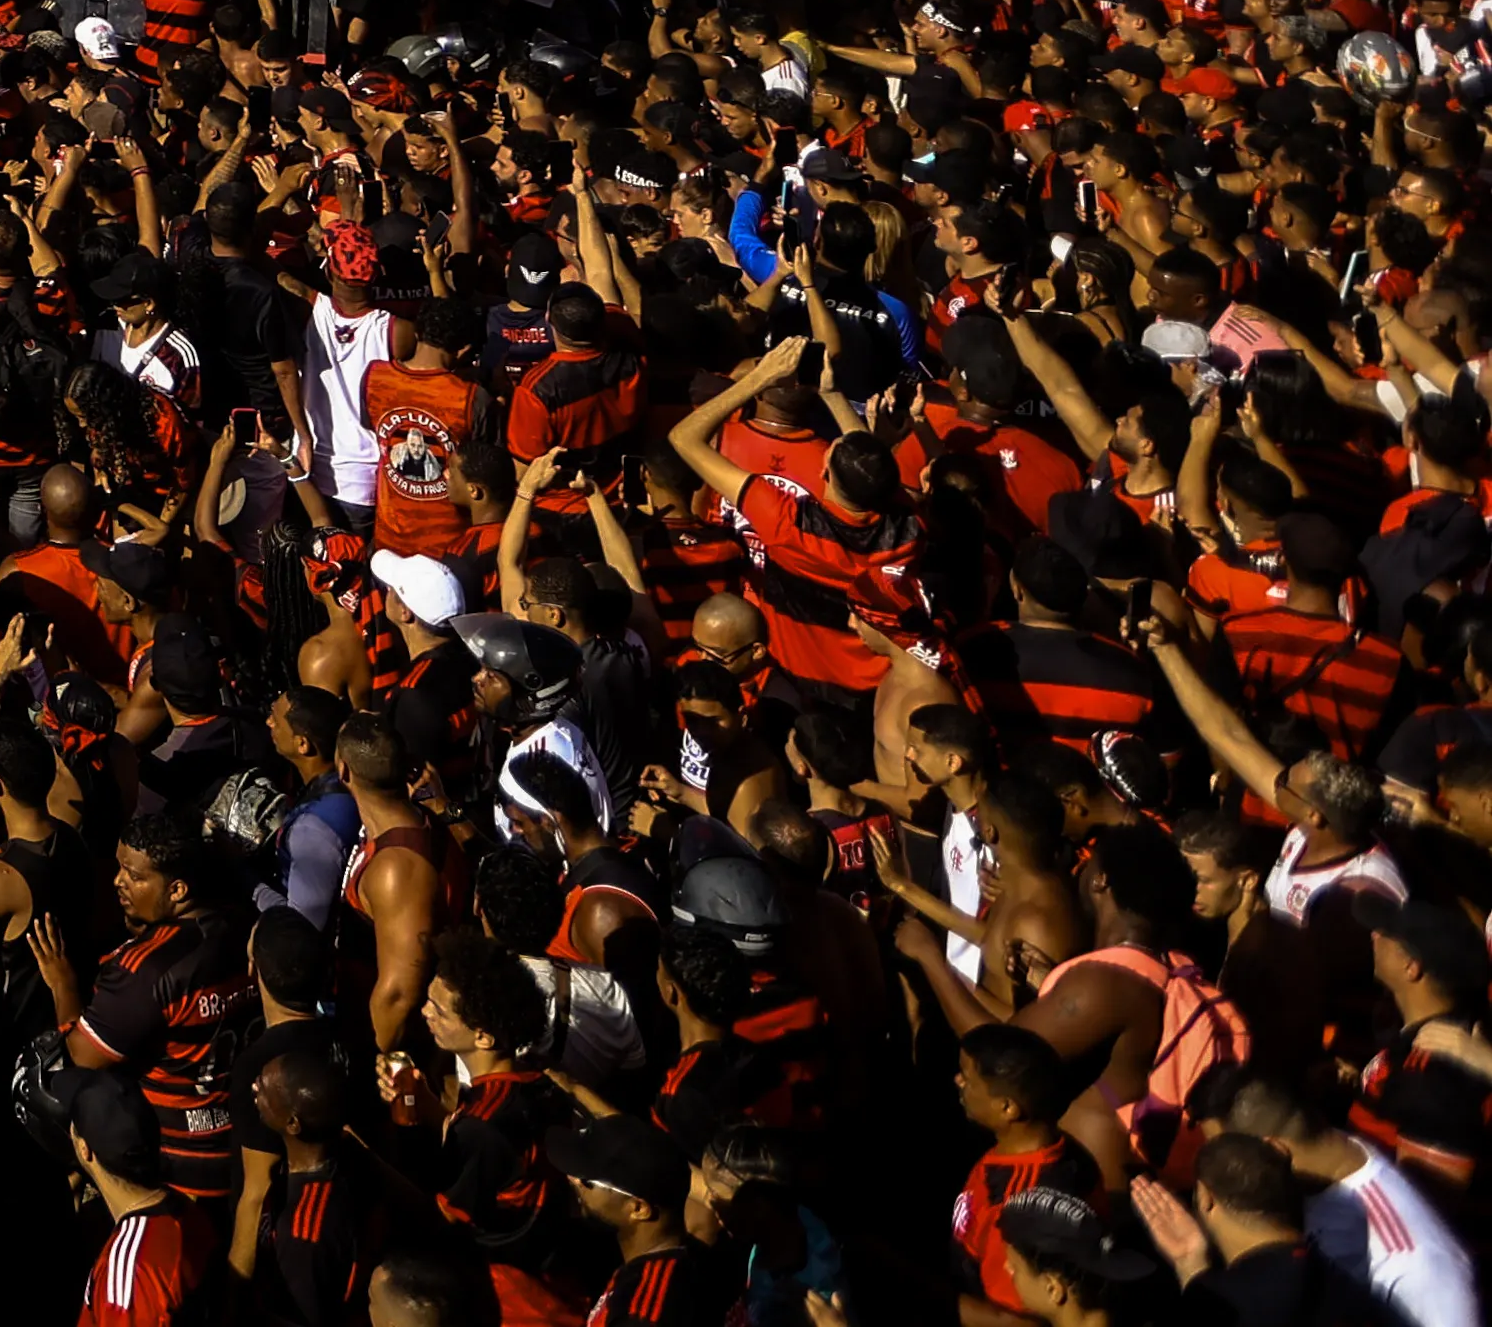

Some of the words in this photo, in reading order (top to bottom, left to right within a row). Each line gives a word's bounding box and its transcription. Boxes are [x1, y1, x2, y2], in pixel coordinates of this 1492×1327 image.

[781, 283, 889, 326] PETOBRAS
[384, 463, 409, 496] FESTA
[420, 478, 445, 499] FAVE
